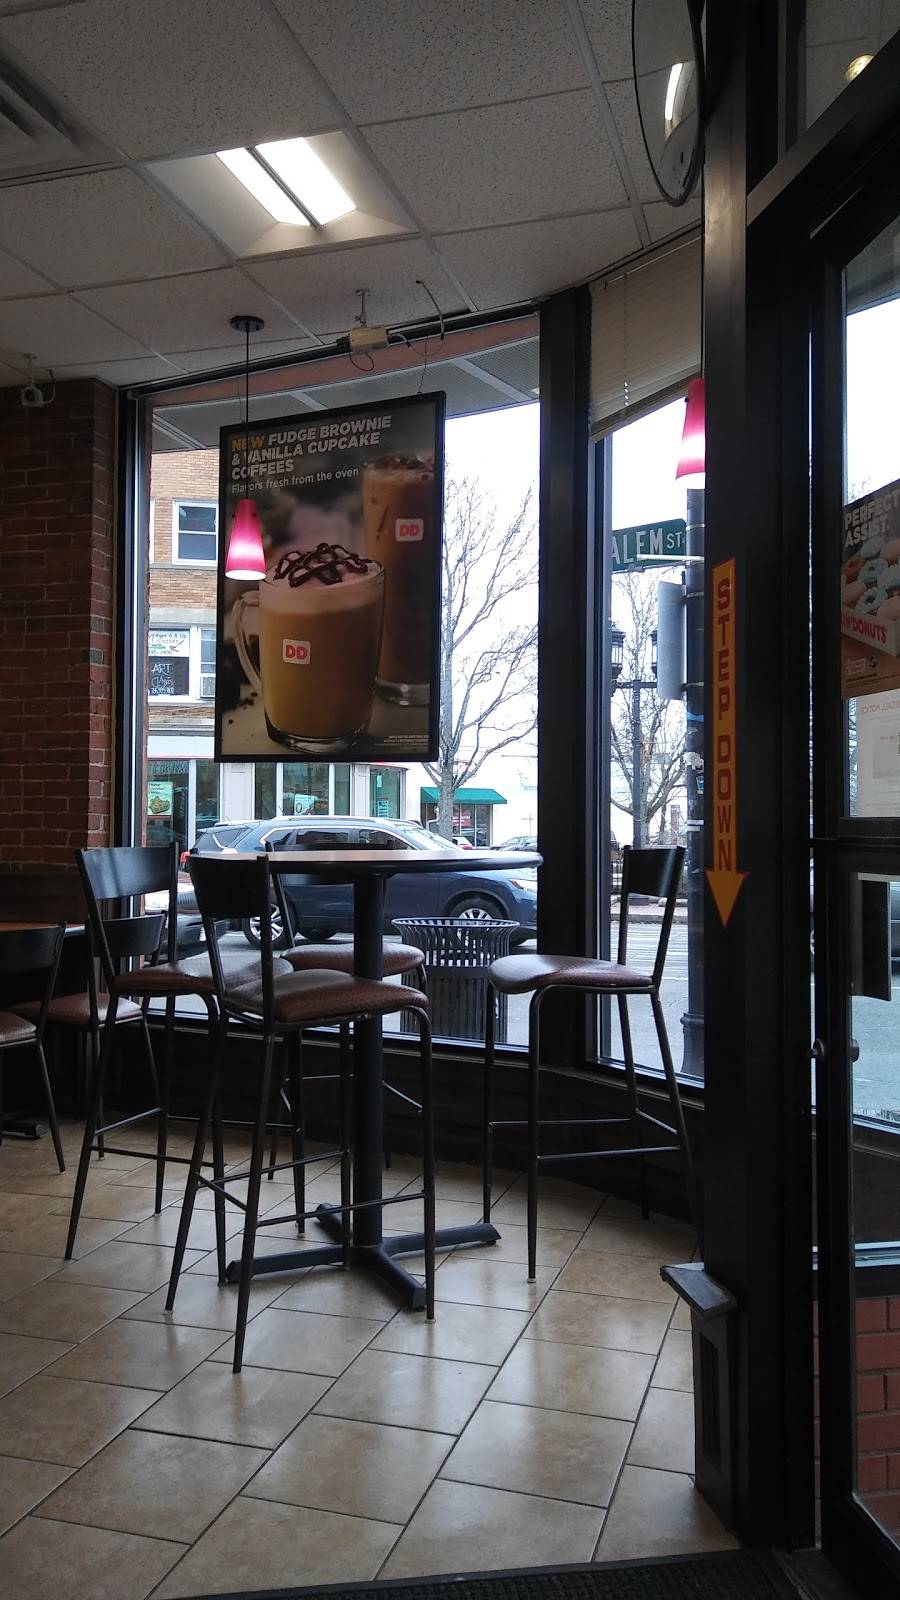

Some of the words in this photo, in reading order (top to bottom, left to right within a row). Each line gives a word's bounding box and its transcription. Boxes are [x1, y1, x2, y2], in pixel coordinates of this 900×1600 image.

[232, 436, 264, 452] NEW
[268, 428, 318, 446] FUDGE
[319, 415, 392, 439] BROWNIE
[231, 453, 240, 466] &
[243, 445, 303, 464] VANILLA
[308, 433, 380, 454] CUPCAKE
[231, 459, 294, 480] COFFEES
[231, 480, 263, 494] Flavors
[265, 476, 289, 489] fresh
[291, 473, 314, 485] from
[316, 469, 332, 481] the
[335, 467, 359, 479] oven
[844, 489, 900, 530] PERFECT
[399, 523, 420, 537] DD
[667, 532, 683, 549] ST
[852, 616, 887, 645] DONUTS
[285, 645, 308, 660] DD
[717, 578, 731, 721] STEP
[151, 663, 172, 676] ART
[717, 734, 732, 871] DOWN
